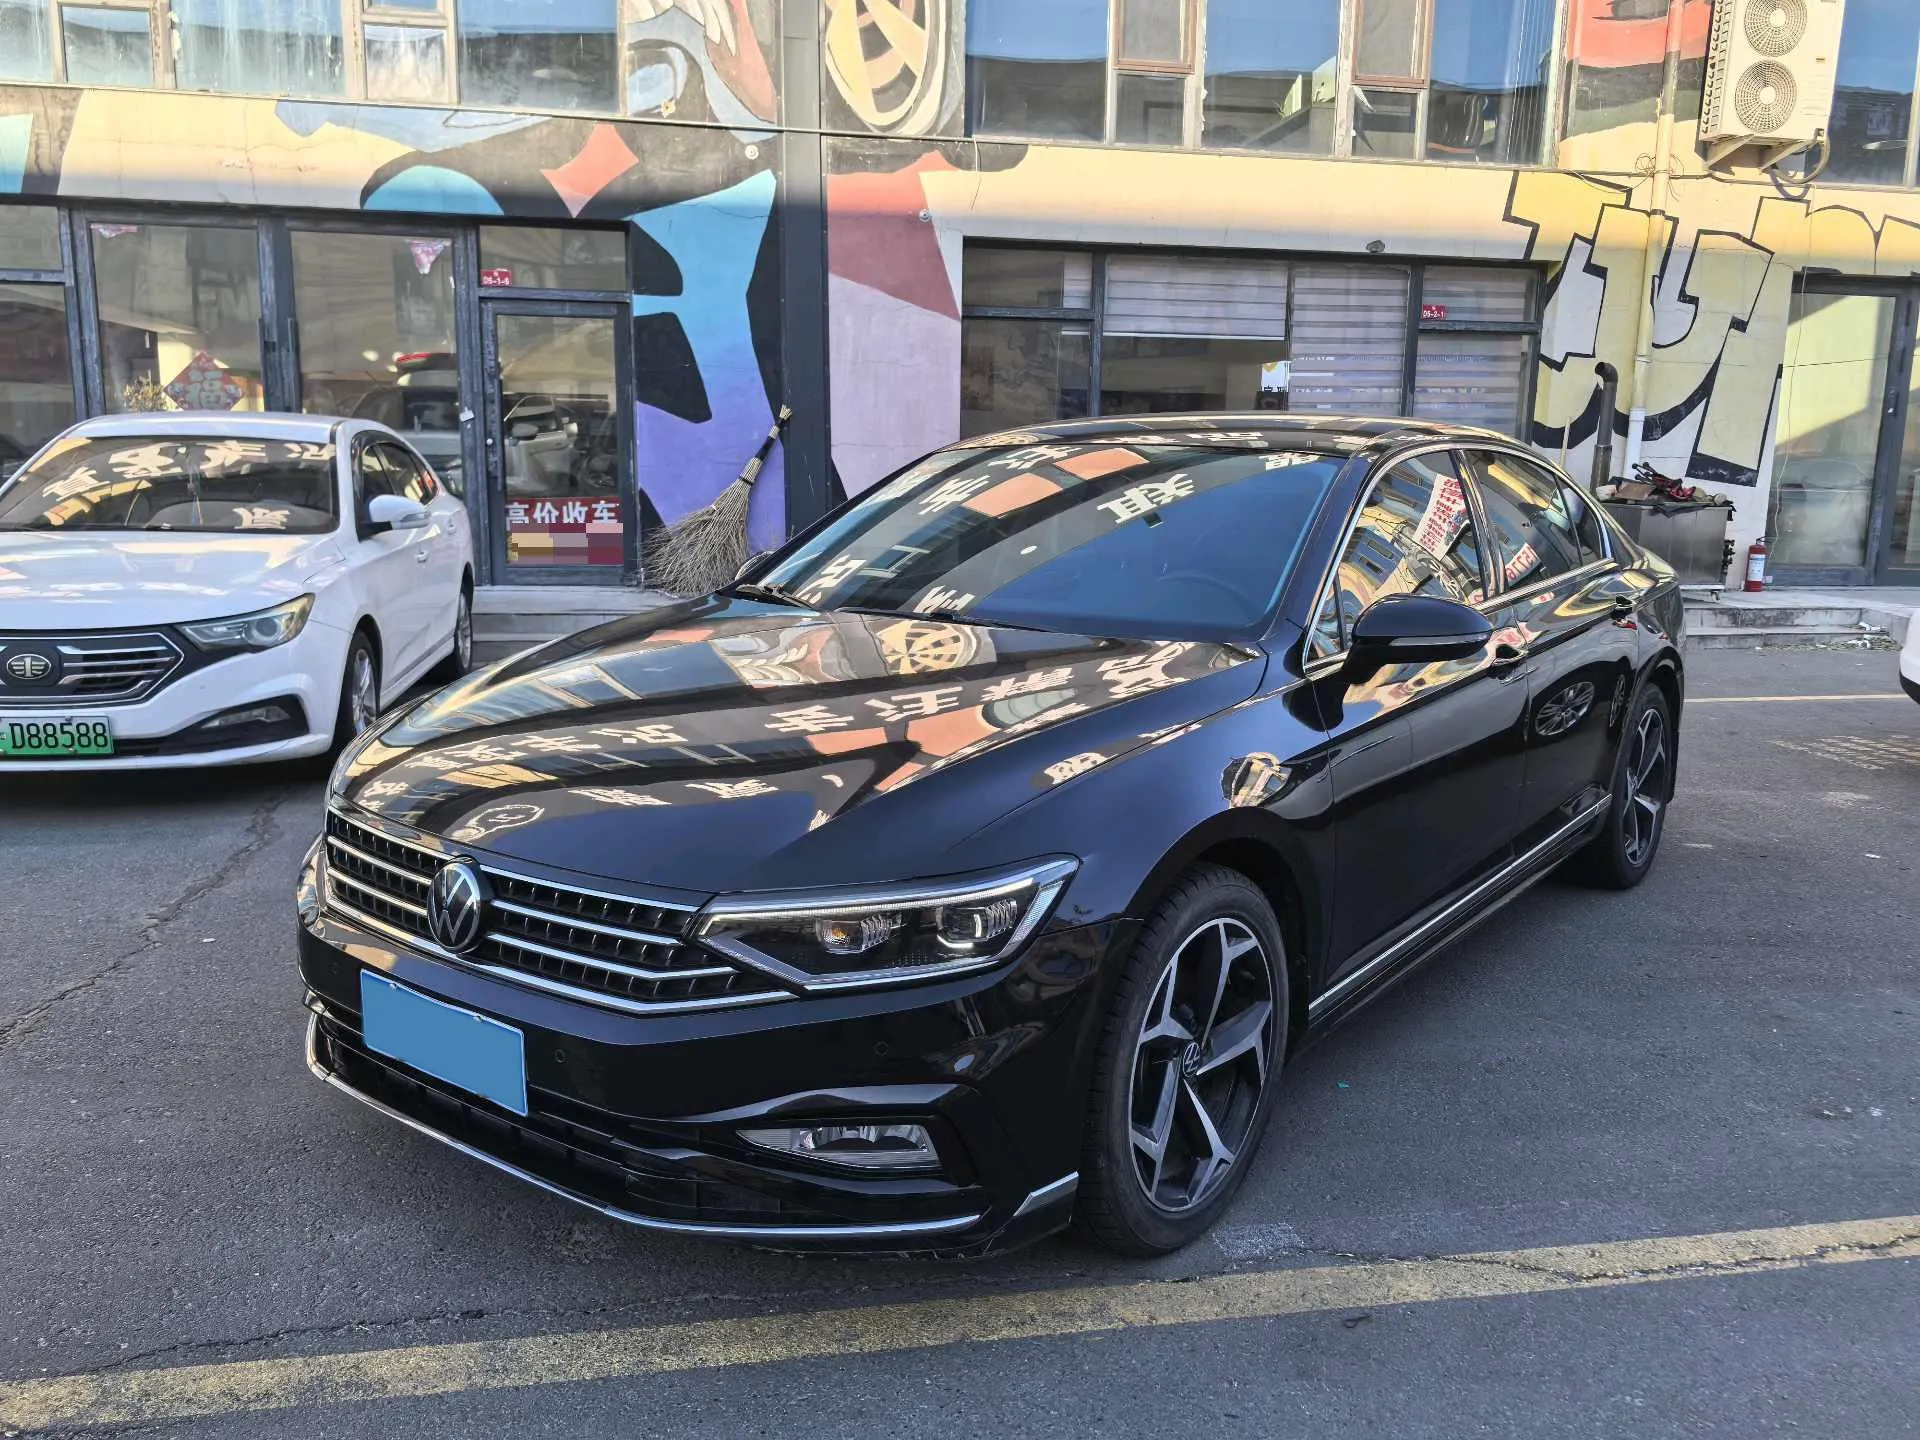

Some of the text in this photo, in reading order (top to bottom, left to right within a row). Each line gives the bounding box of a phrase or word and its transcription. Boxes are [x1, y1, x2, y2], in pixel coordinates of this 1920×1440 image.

[184, 368, 229, 410] 福
[505, 500, 618, 525] 高价收车
[9, 722, 108, 749] D88588
